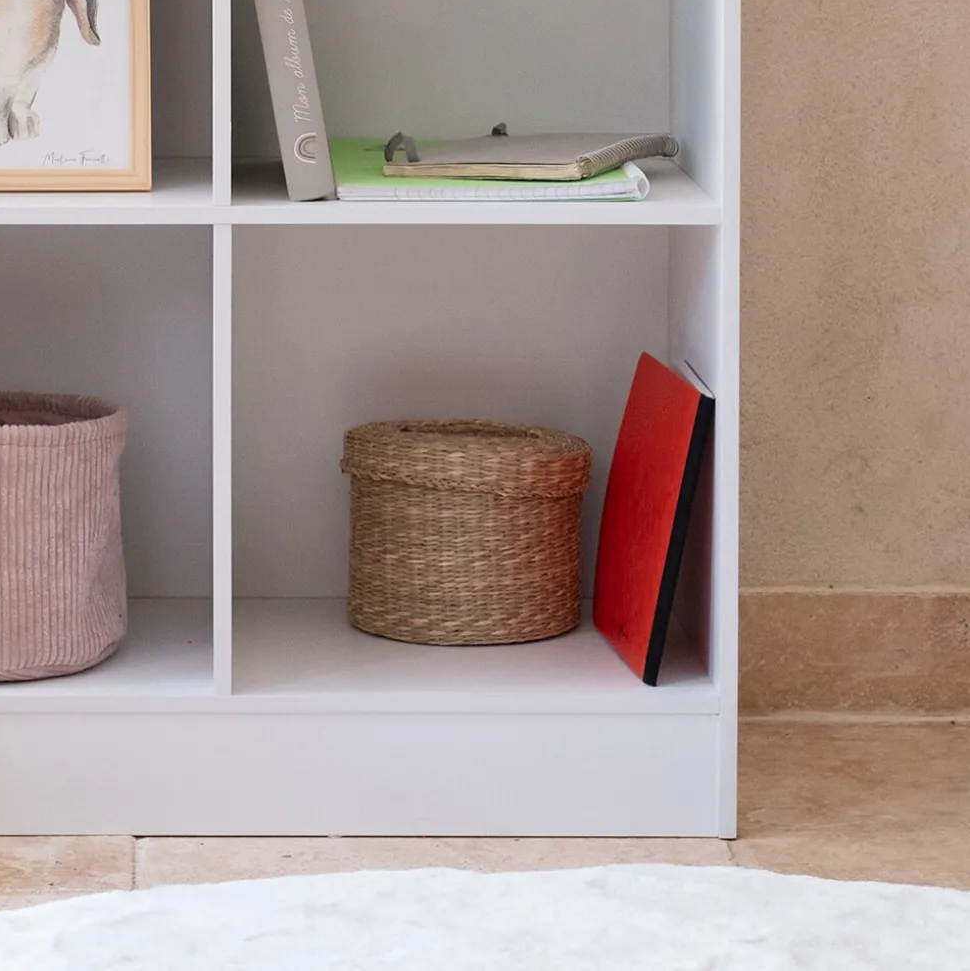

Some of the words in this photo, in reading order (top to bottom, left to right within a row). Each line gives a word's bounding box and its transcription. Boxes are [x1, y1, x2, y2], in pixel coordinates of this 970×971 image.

[279, 7, 294, 25] de
[283, 28, 303, 78] album
[292, 82, 311, 123] Mon
